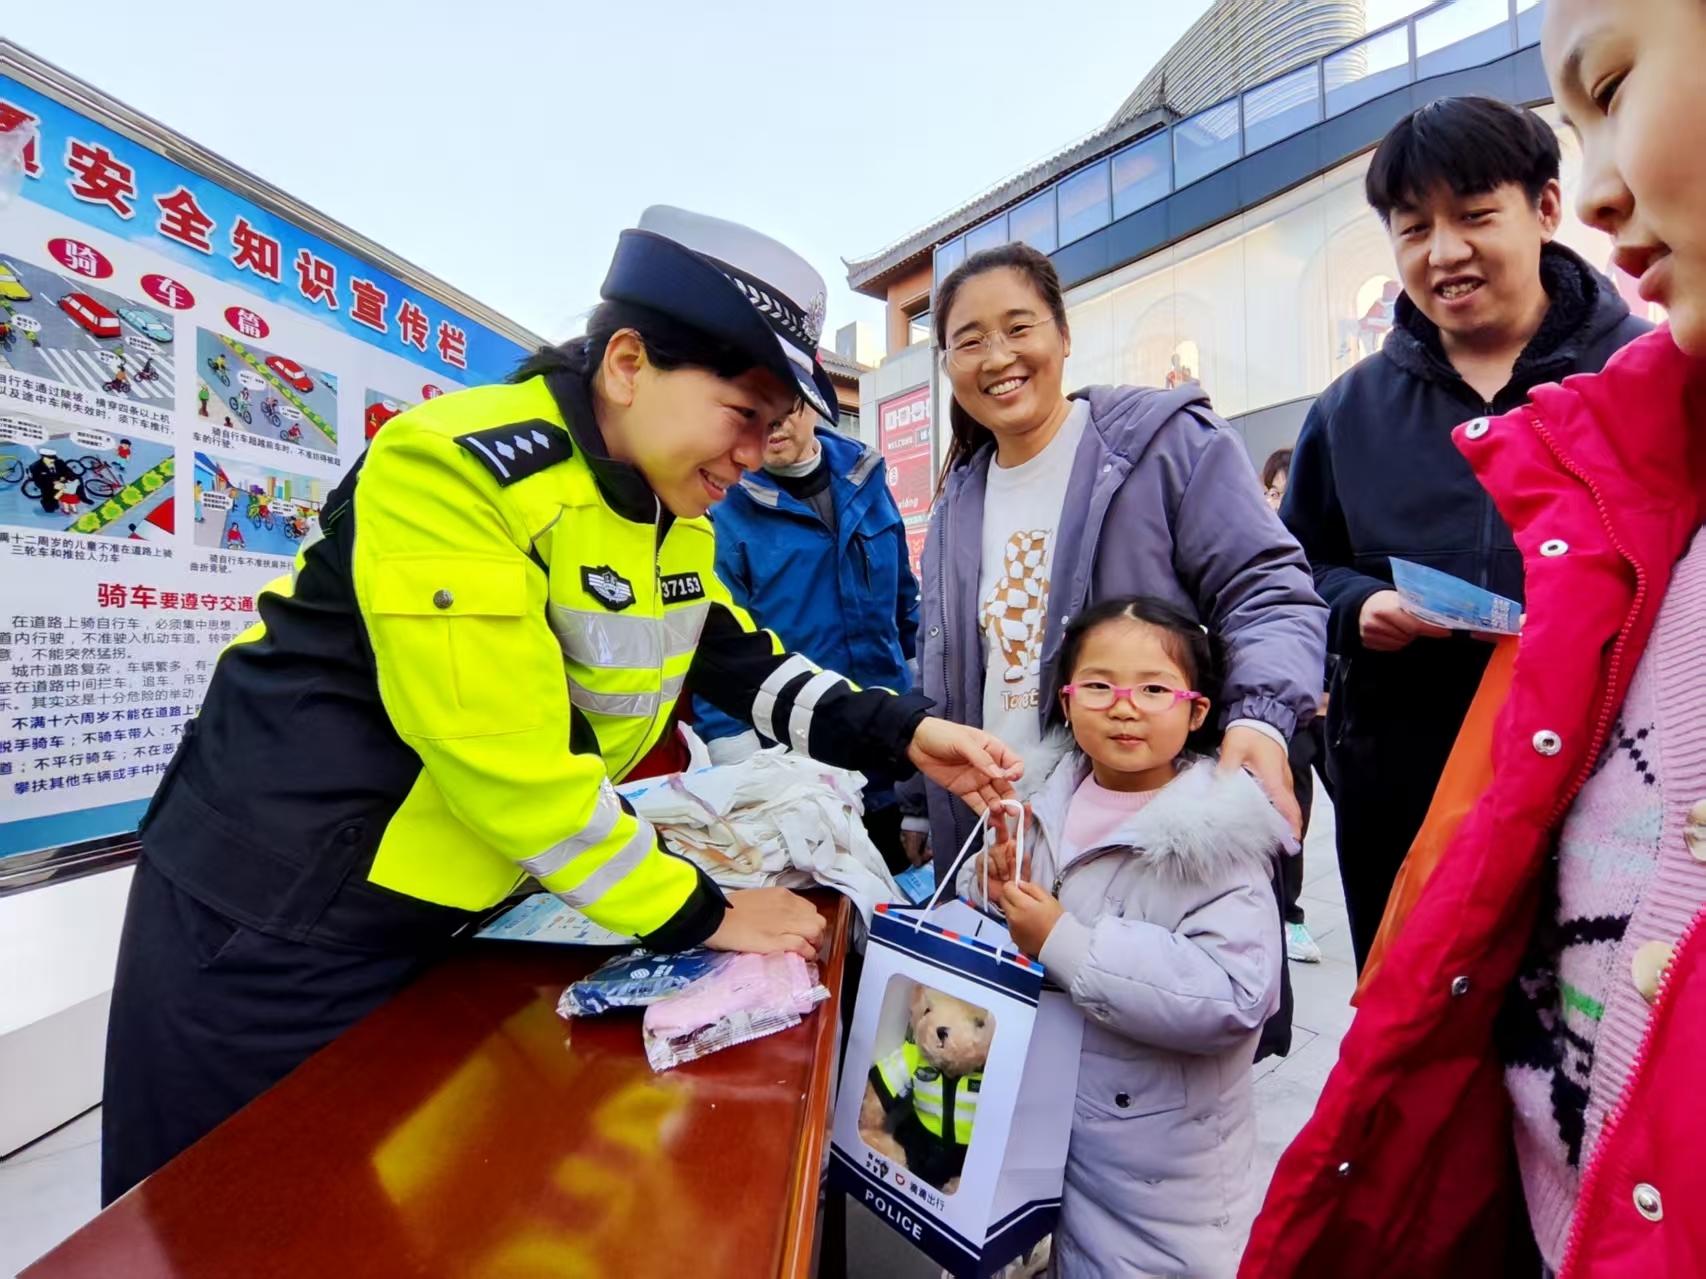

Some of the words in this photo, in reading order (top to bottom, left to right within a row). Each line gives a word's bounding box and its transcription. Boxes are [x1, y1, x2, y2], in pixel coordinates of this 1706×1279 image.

[98, 584, 257, 612] 骑车要遵守交通
[662, 577, 700, 598] 37153
[865, 1189, 923, 1240] POLICE
